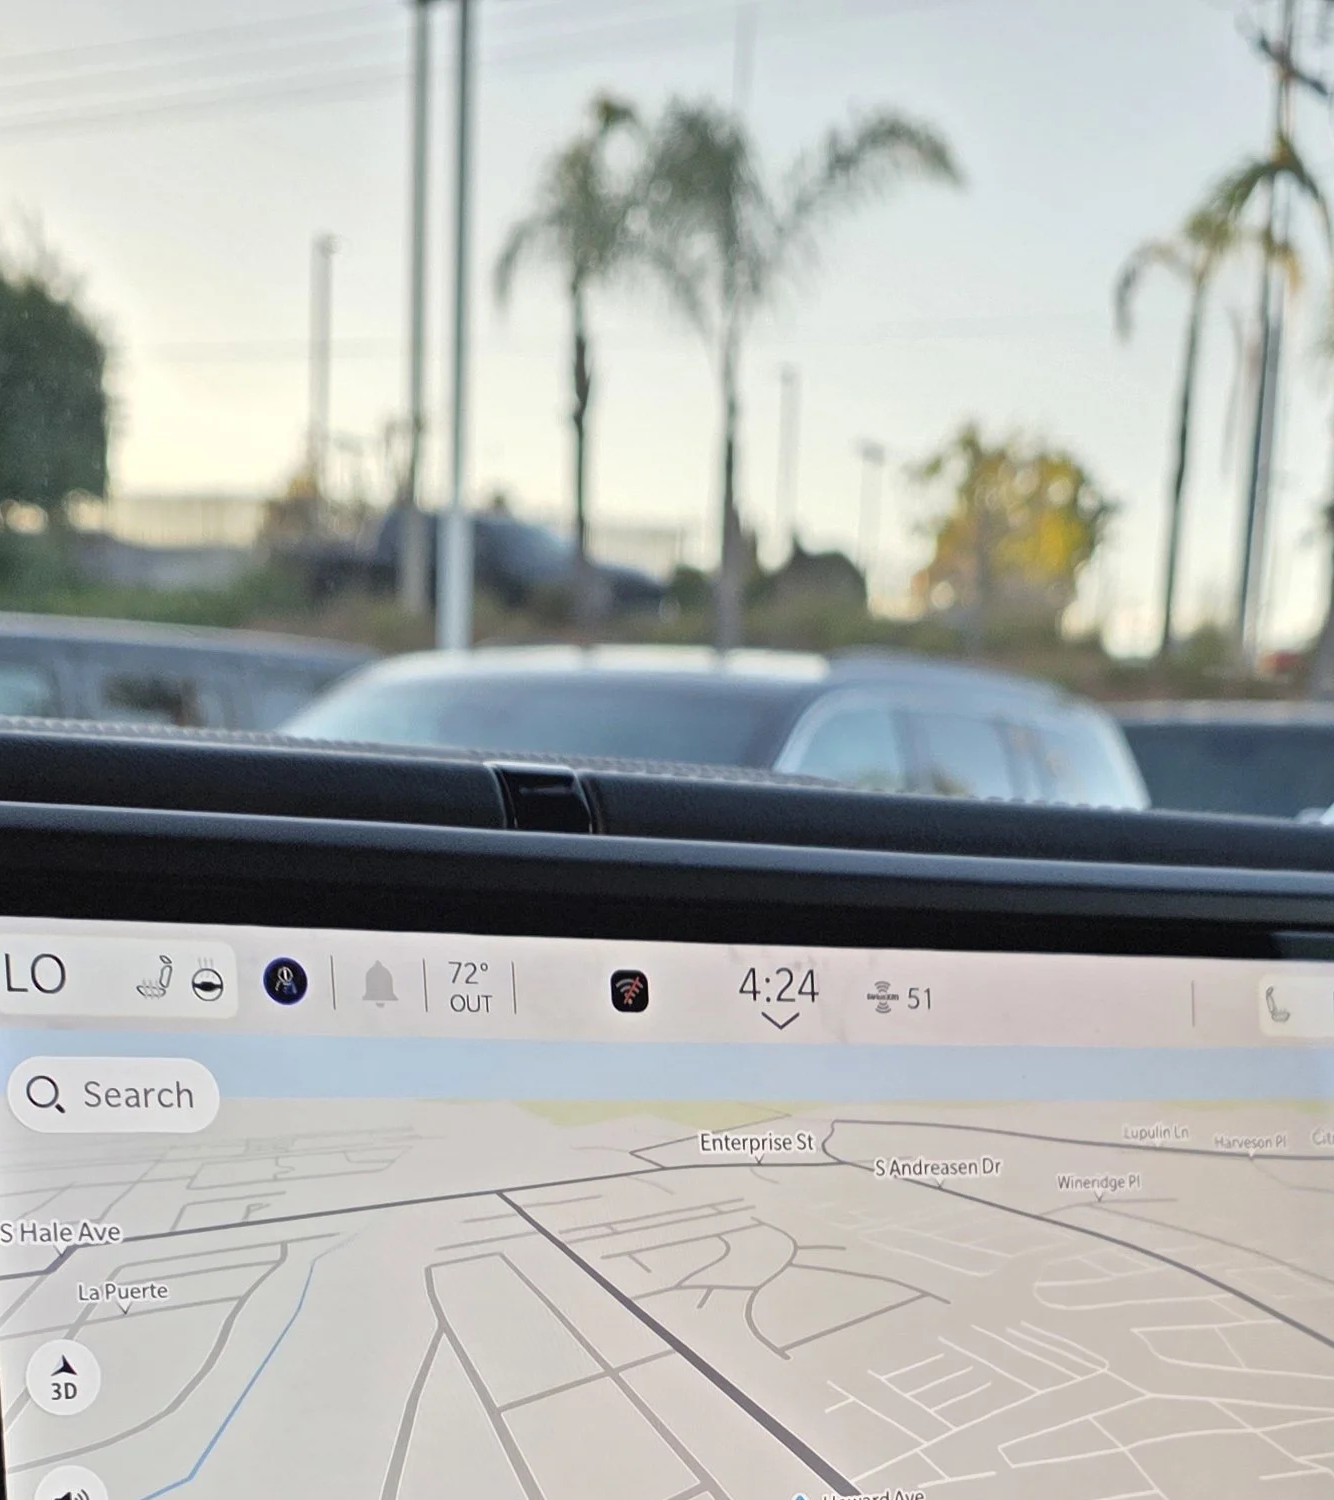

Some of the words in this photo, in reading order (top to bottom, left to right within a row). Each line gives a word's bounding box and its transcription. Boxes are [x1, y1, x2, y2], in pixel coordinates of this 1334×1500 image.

[5, 953, 66, 994] LO
[448, 961, 490, 985] 72°
[738, 967, 820, 1003] 4:24
[450, 994, 492, 1014] OUT
[907, 987, 931, 1010] 51
[84, 1081, 195, 1109] Search
[1124, 1126, 1170, 1141] Lupulin
[1174, 1126, 1189, 1139] Ln
[700, 1134, 792, 1154] Enterprise
[796, 1134, 814, 1151] St
[875, 1160, 885, 1176] S
[889, 1159, 978, 1176] Andreasen
[982, 1160, 1002, 1175] Dr
[1129, 1174, 1140, 1188] Pl
[0, 1223, 13, 1243] S
[21, 1222, 72, 1243] Hale
[78, 1223, 121, 1242] Ave
[78, 1285, 100, 1301] La
[105, 1283, 168, 1300] Puerte
[51, 1383, 78, 1401] 3D
